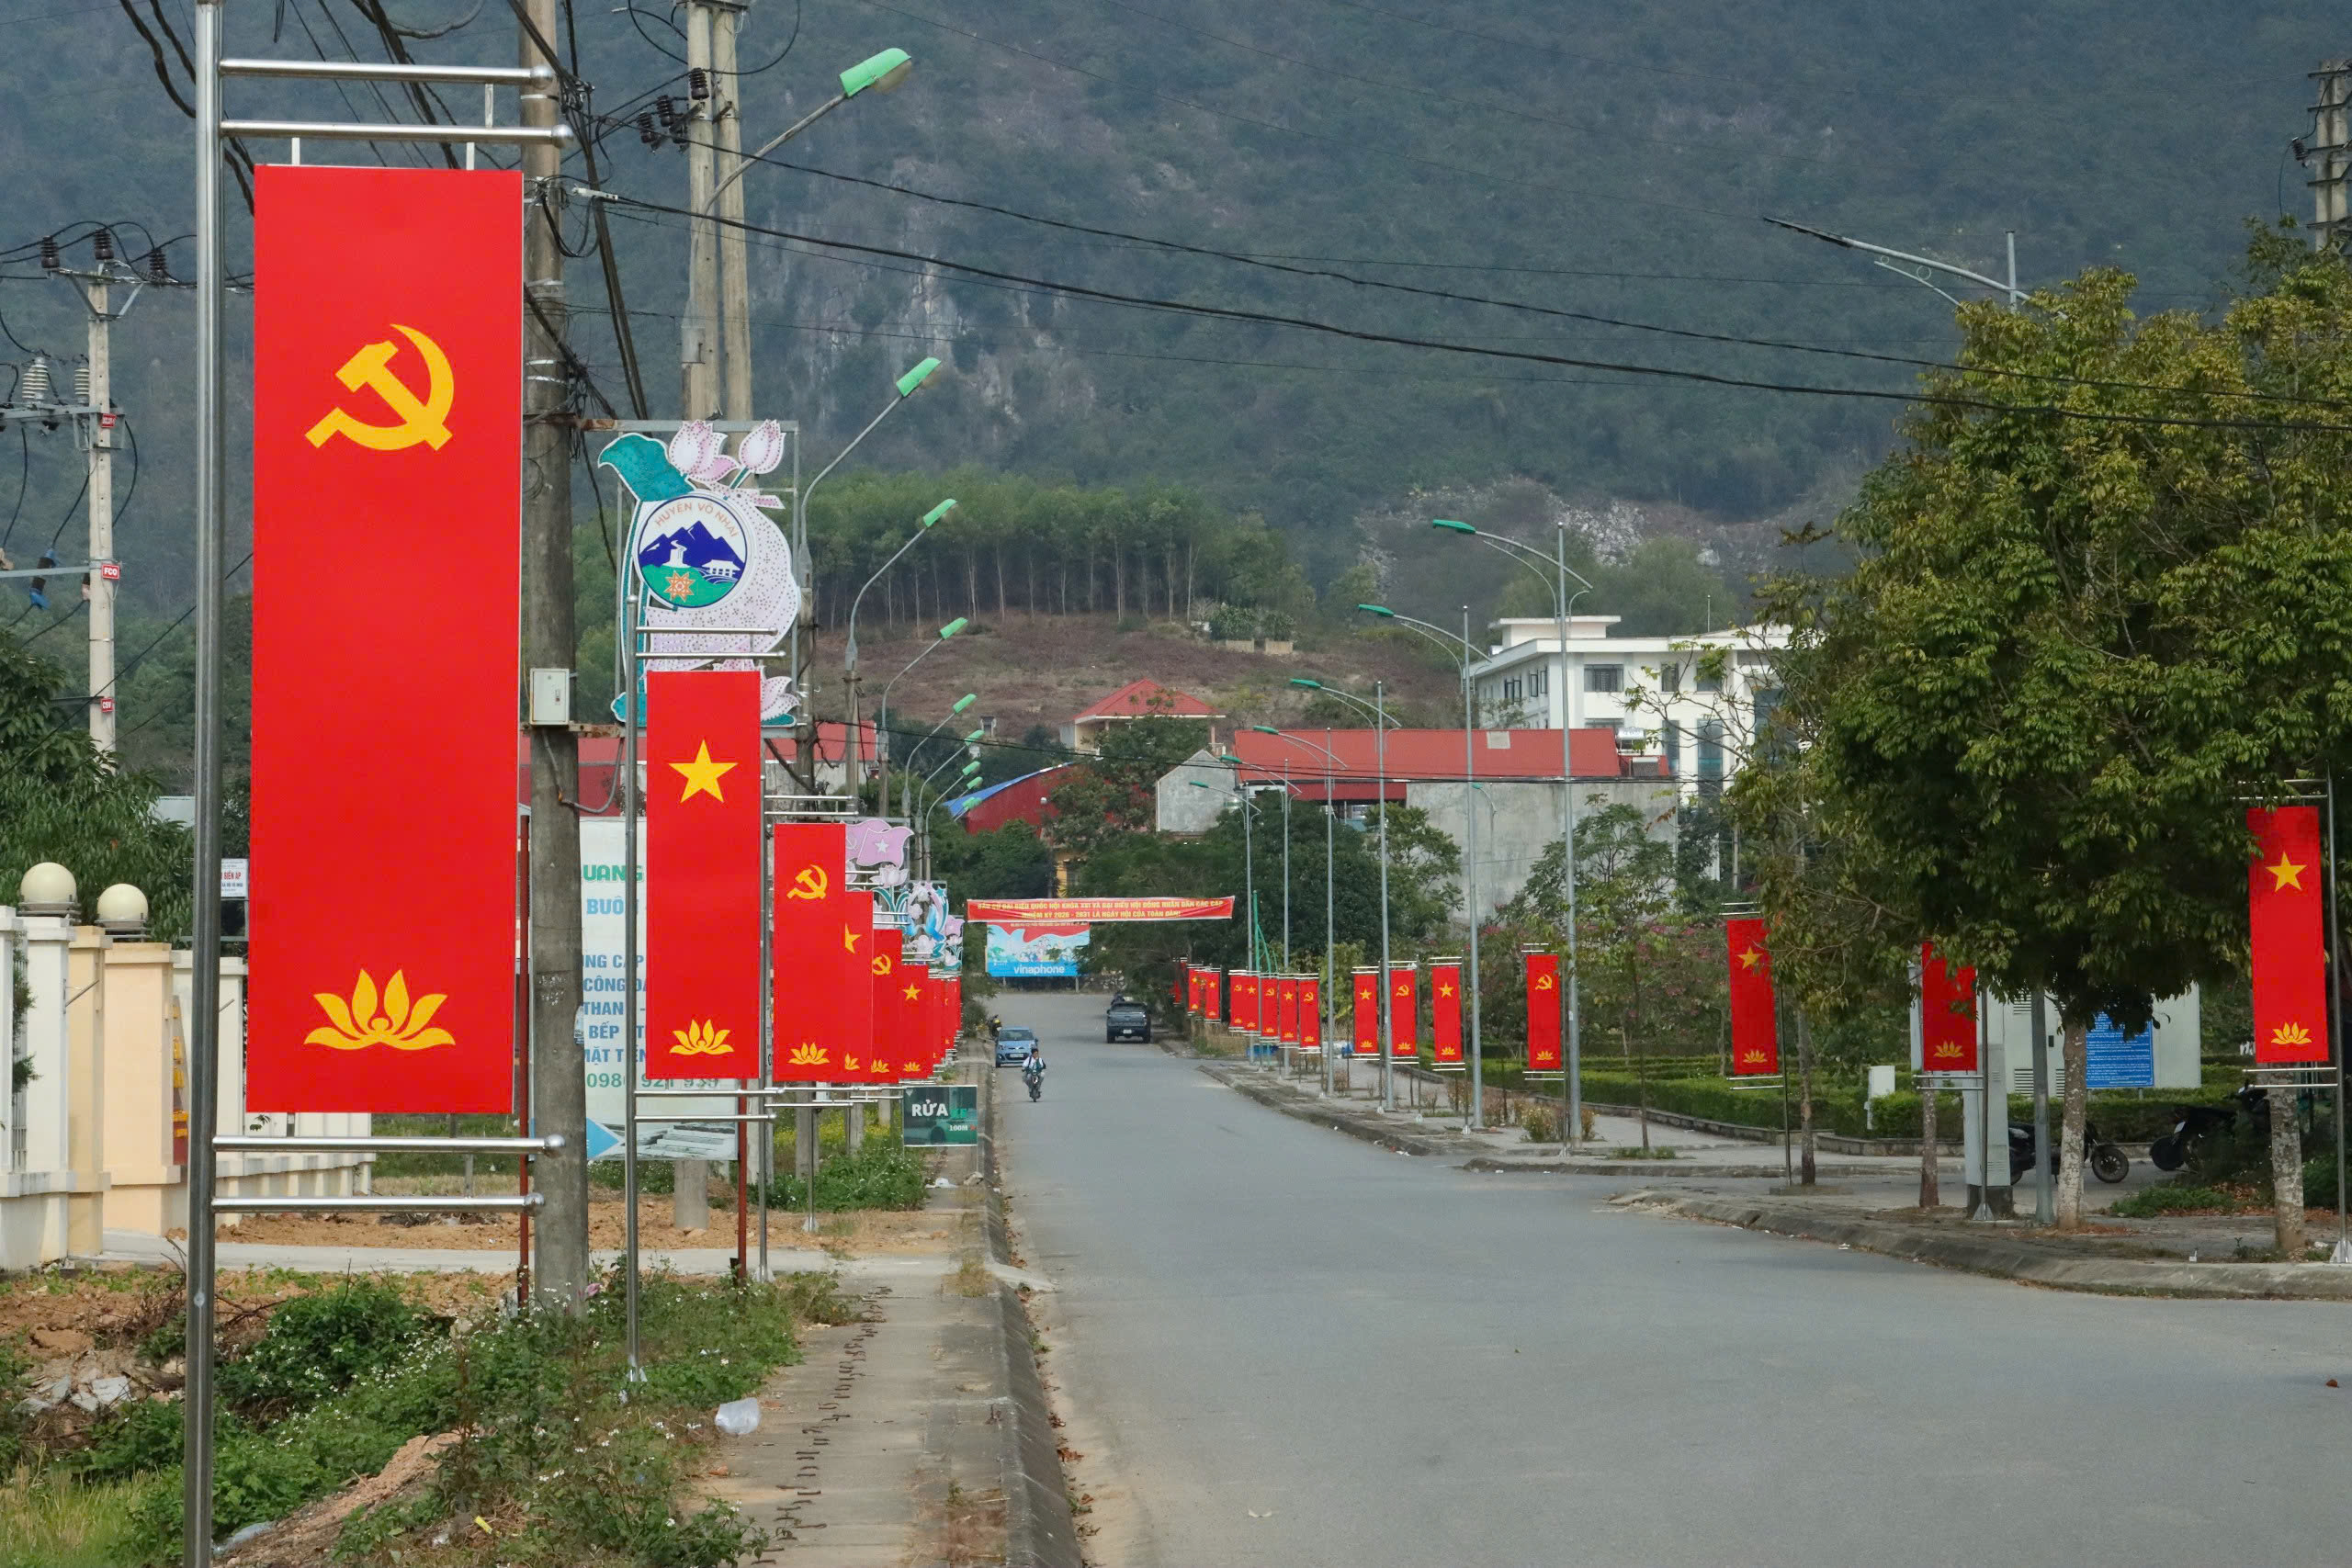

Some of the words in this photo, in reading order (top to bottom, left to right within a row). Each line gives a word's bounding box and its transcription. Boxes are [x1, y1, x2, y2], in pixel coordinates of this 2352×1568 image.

[715, 511, 740, 537] NHAI
[583, 864, 643, 882] UANG
[1013, 964, 1066, 975] vinaphone
[589, 1021, 619, 1039] BẾP
[586, 1073, 626, 1088] 098
[911, 1099, 948, 1117] RỬA
